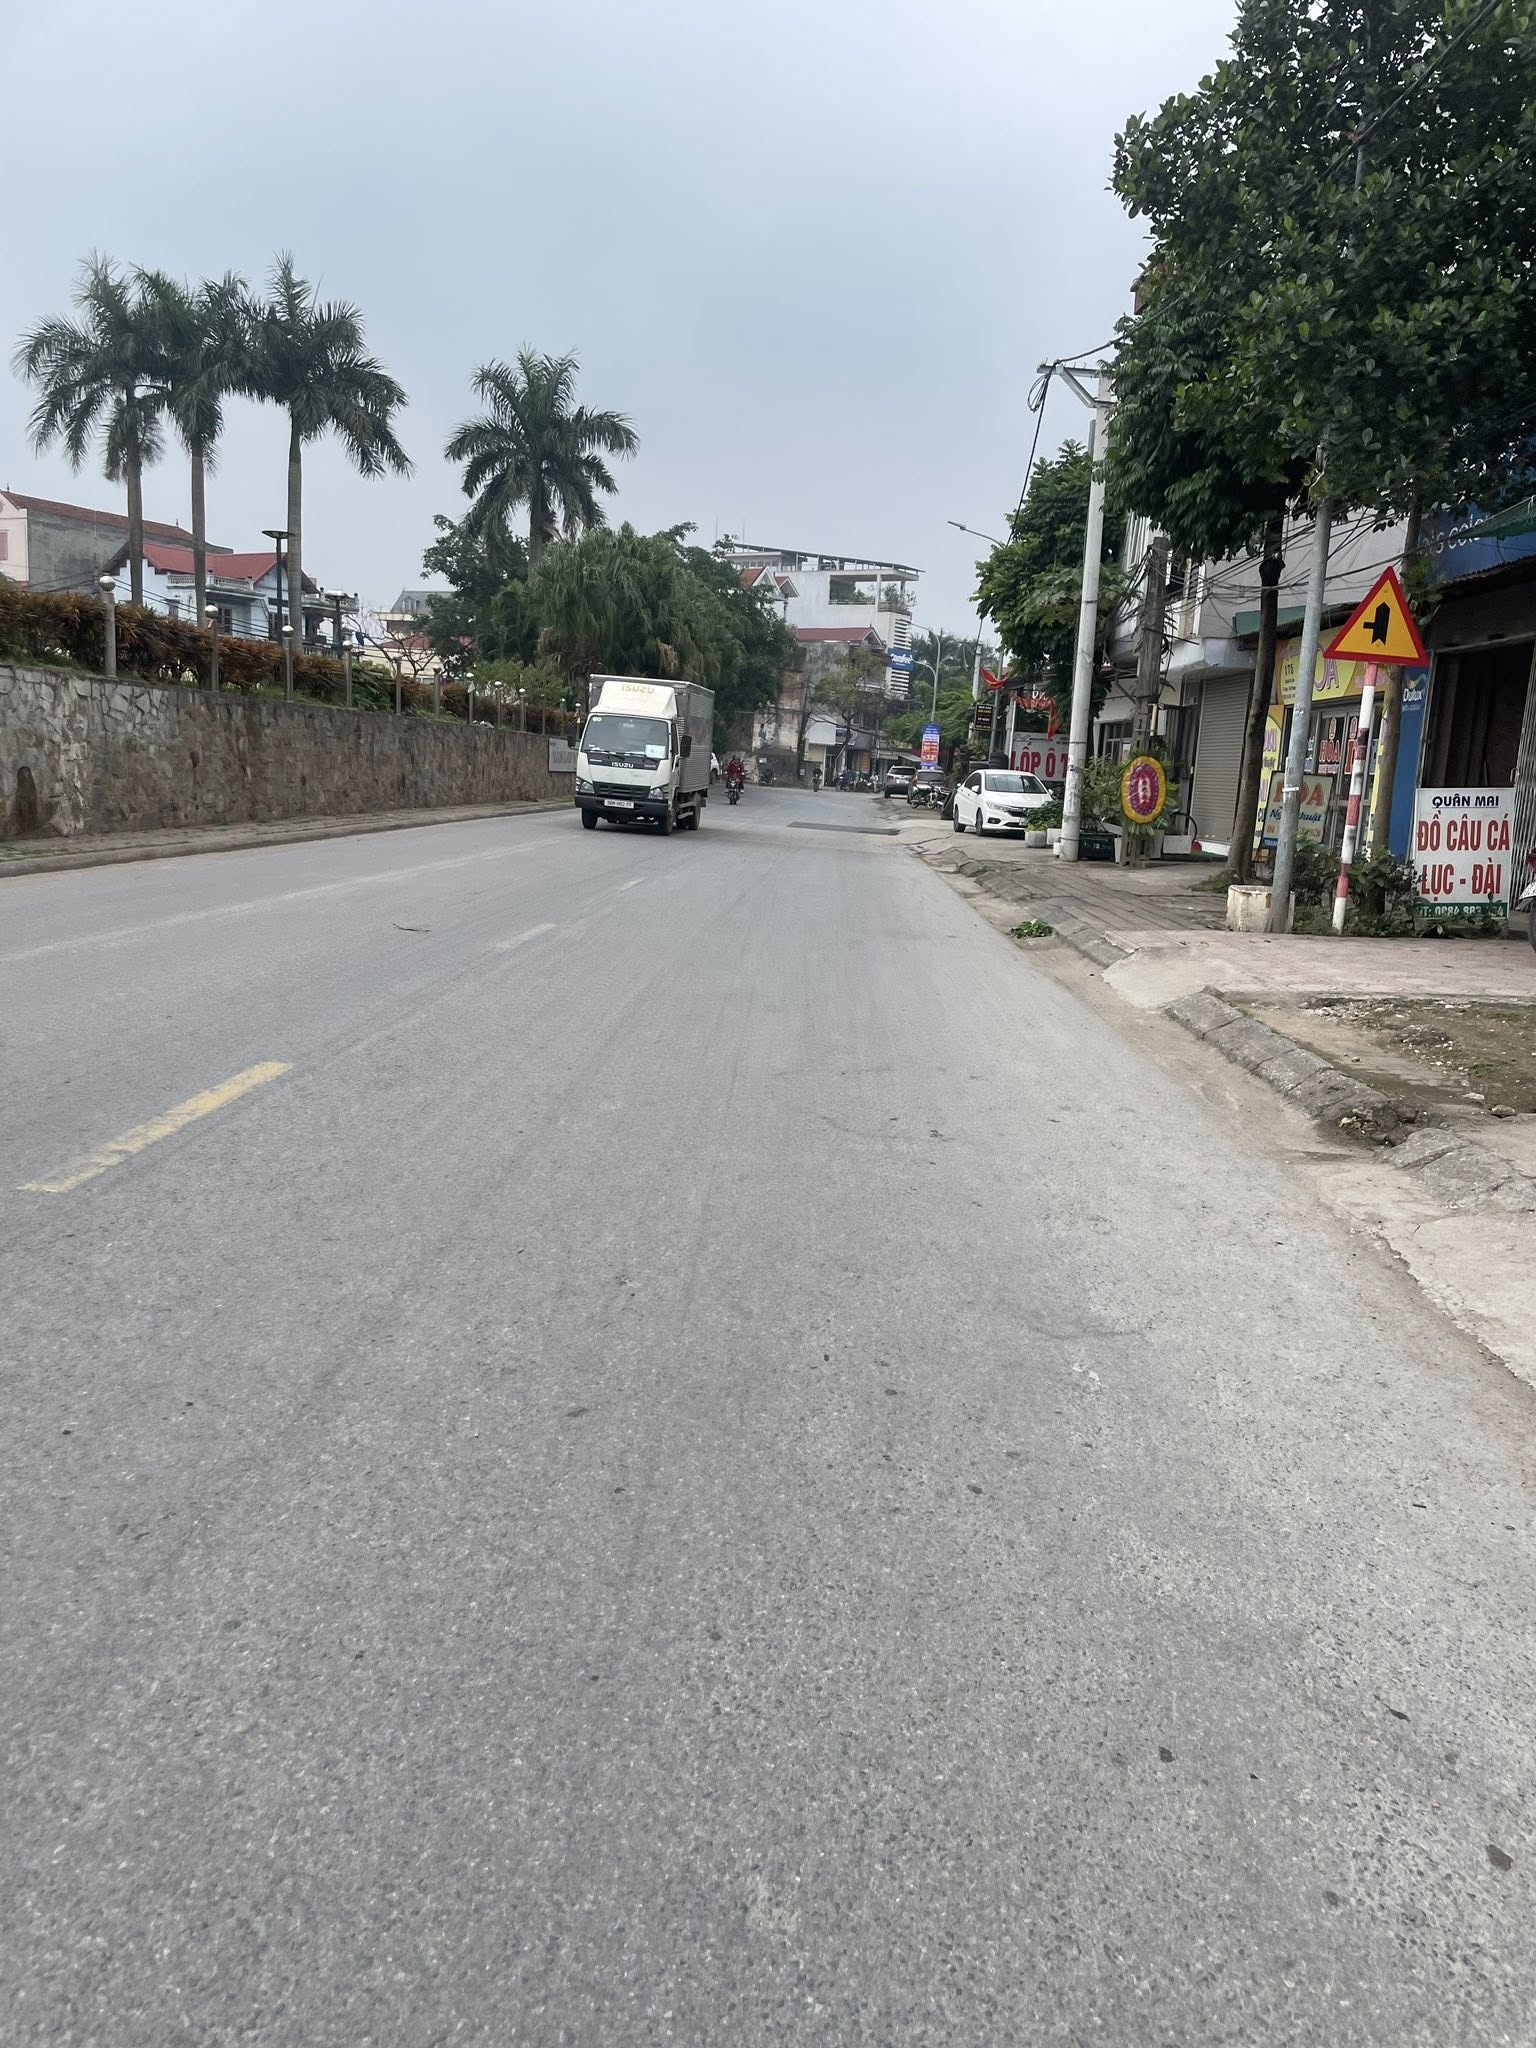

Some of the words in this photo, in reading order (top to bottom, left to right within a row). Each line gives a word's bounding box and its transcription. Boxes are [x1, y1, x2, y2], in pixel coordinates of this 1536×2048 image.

[621, 684, 655, 694] ISUZU
[1403, 688, 1423, 702] Dulux
[611, 761, 635, 769] ISUZU
[1045, 748, 1056, 778] Ô
[1432, 793, 1471, 808] QUÂN
[1474, 795, 1499, 807] MAI
[1417, 810, 1442, 851] ĐỒ
[1446, 813, 1482, 851] CÂU
[1487, 813, 1510, 851] CÁ
[1421, 863, 1454, 901] LỤC
[1471, 857, 1502, 894] ĐÀI
